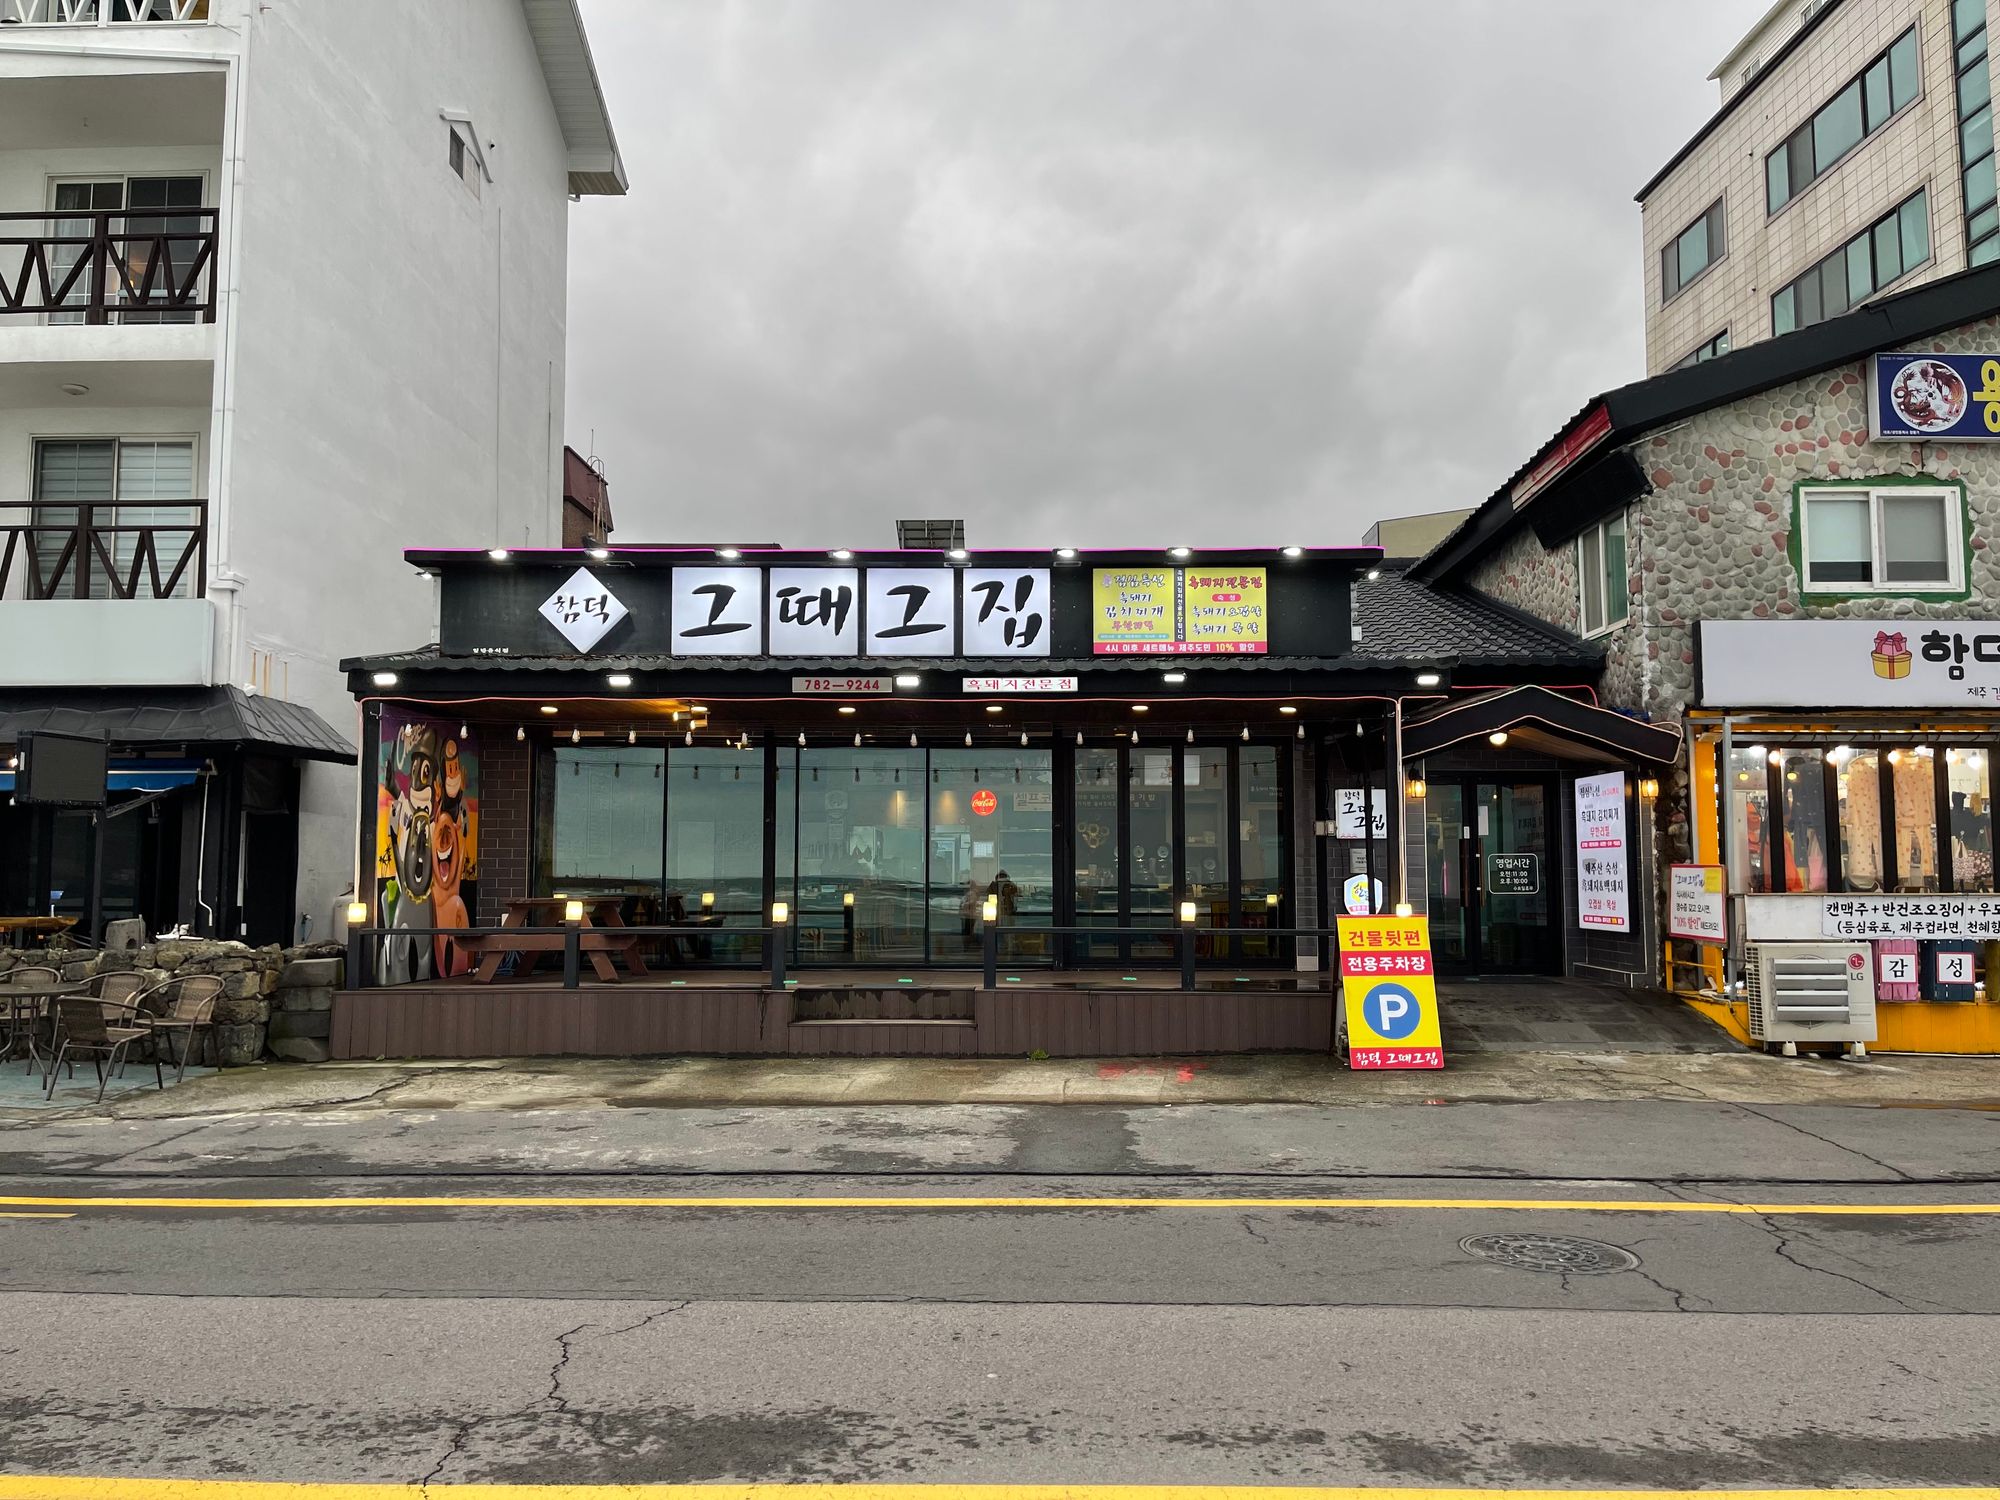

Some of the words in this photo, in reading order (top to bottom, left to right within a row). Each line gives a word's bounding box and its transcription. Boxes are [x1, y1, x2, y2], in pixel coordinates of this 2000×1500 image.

[553, 594, 609, 624] 함덕
[1105, 644, 1119, 652] 4시
[1122, 644, 1138, 652] 이후
[1179, 643, 1211, 652] 제주도민
[1215, 643, 1234, 652] 10%
[967, 678, 1072, 690] 흑돼지전문점
[1967, 687, 1987, 699] 제주
[1496, 858, 1530, 868] 영업시간
[1837, 920, 1896, 934] (등심육포,
[1900, 920, 1963, 935] 제주컵라면,
[1348, 930, 1421, 947] 건물뒷편
[1347, 956, 1426, 972] 전용주차장
[1850, 972, 1864, 981] LG
[1379, 994, 1409, 1031] P
[1356, 1052, 1381, 1066] 함덕
